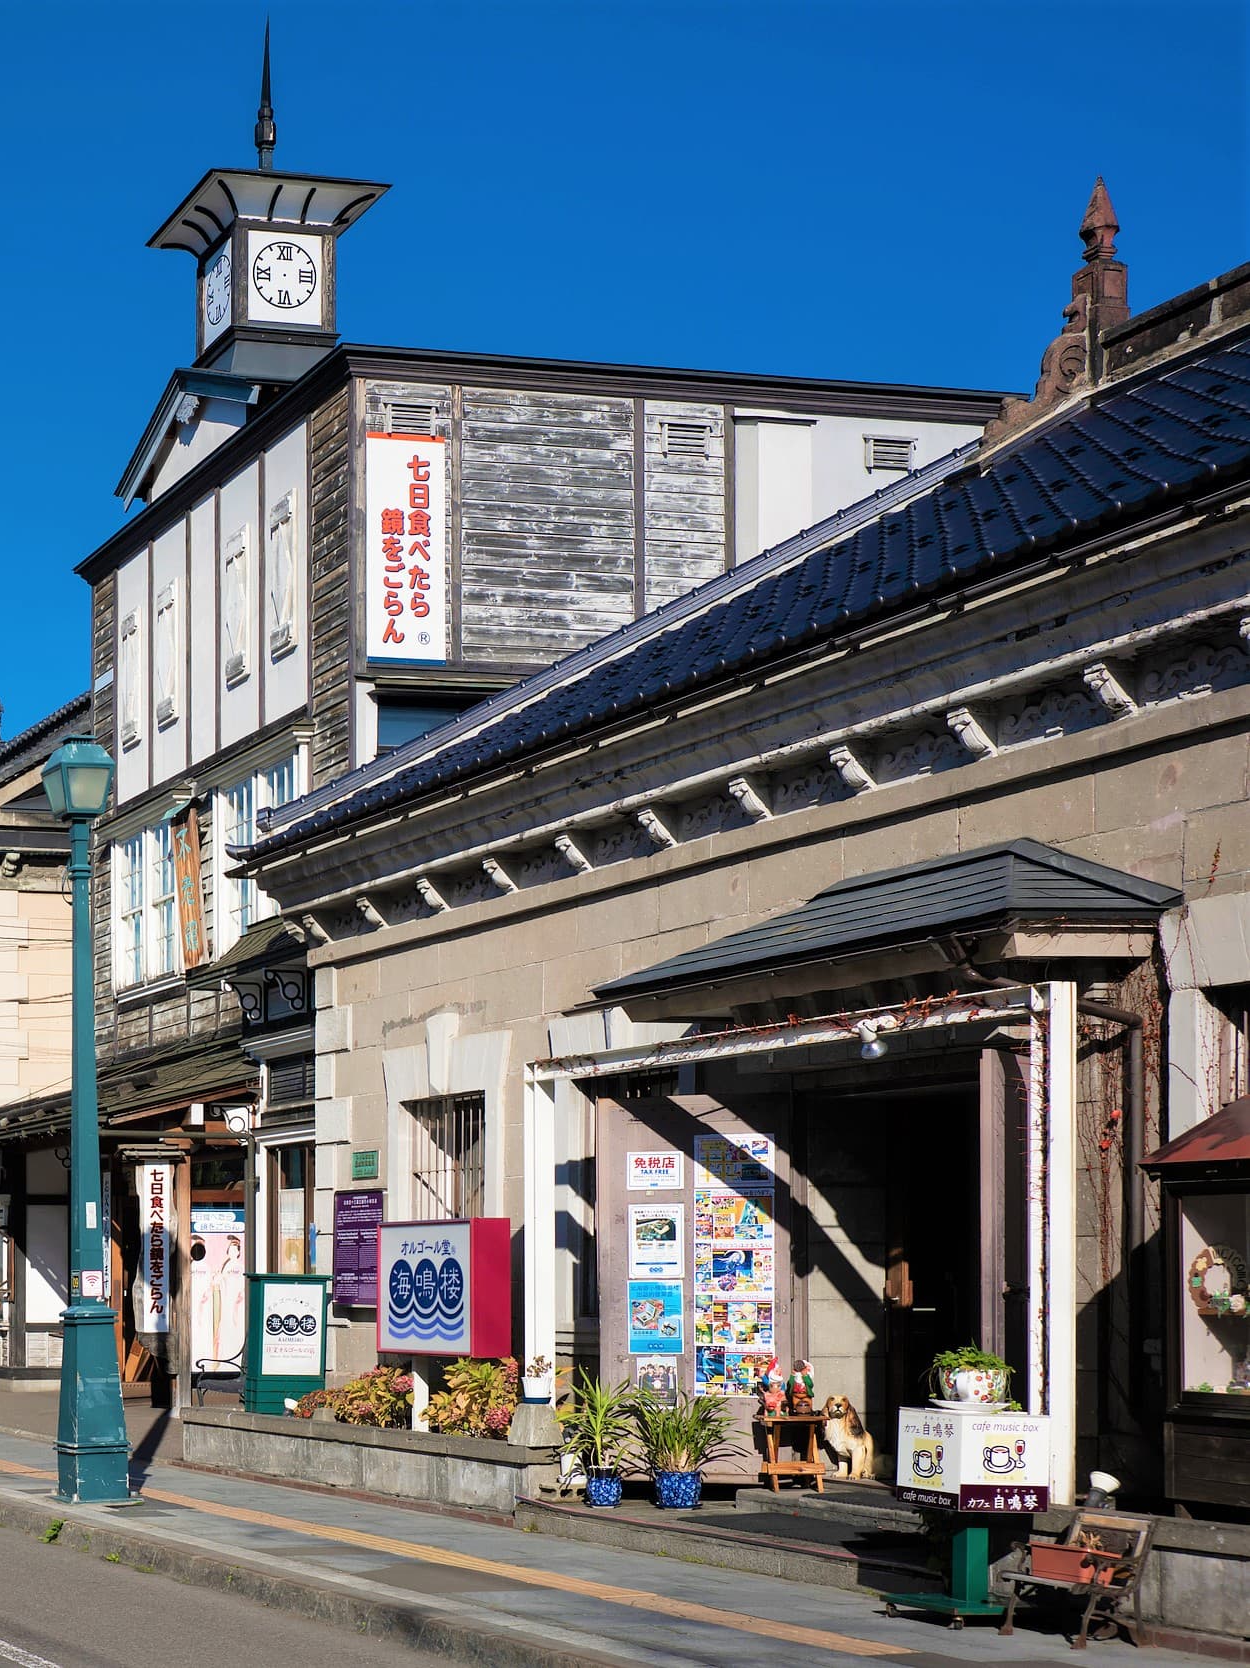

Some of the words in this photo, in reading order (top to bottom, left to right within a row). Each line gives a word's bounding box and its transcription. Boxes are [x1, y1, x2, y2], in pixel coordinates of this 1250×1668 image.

[407, 455, 431, 618] 七日食べたら
[381, 508, 405, 644] 鏡をごらん
[634, 1156, 676, 1169] 免税店
[150, 1169, 164, 1314] 七日食べたら鏡をごらん
[401, 1239, 452, 1256] オルゴール堂
[391, 1266, 461, 1300] 海鳴楼
[267, 1316, 316, 1331] 海鳴楼
[972, 1421, 991, 1431] cafe
[993, 1422, 1021, 1432] music
[1023, 1422, 1039, 1432] box
[902, 1490, 917, 1502] cafe
[917, 1493, 938, 1504] music
[938, 1495, 953, 1505] box
